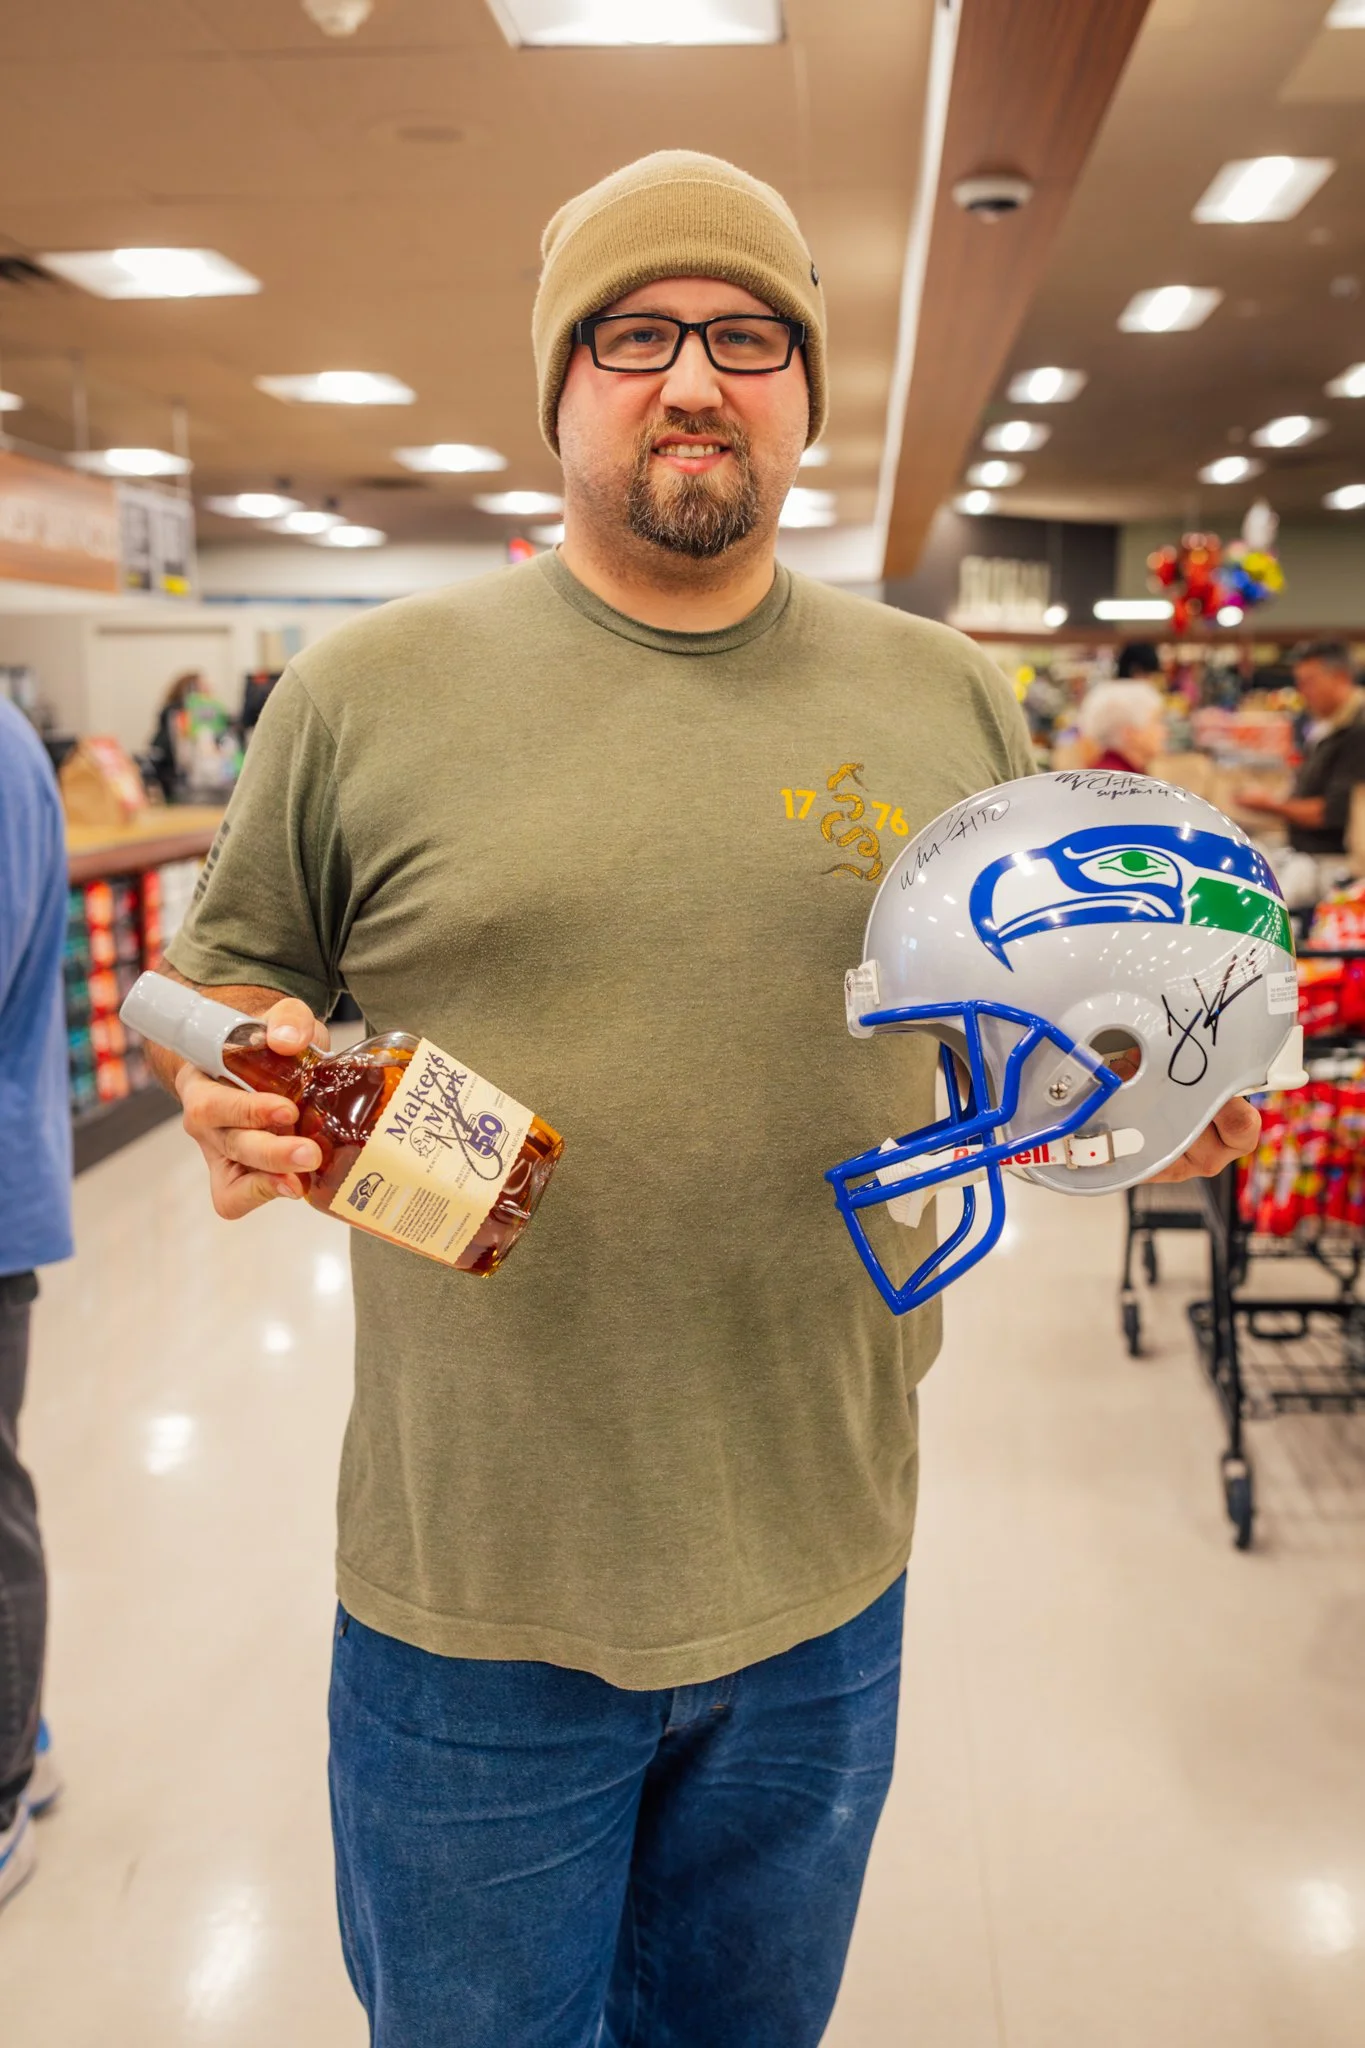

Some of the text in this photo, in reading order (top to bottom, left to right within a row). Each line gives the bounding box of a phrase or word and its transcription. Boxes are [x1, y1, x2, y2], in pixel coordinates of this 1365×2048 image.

[781, 788, 817, 819] 17
[872, 801, 909, 837] 76
[383, 1052, 444, 1144] Maker's
[422, 1069, 467, 1132] Mark
[471, 1115, 502, 1156] 50
